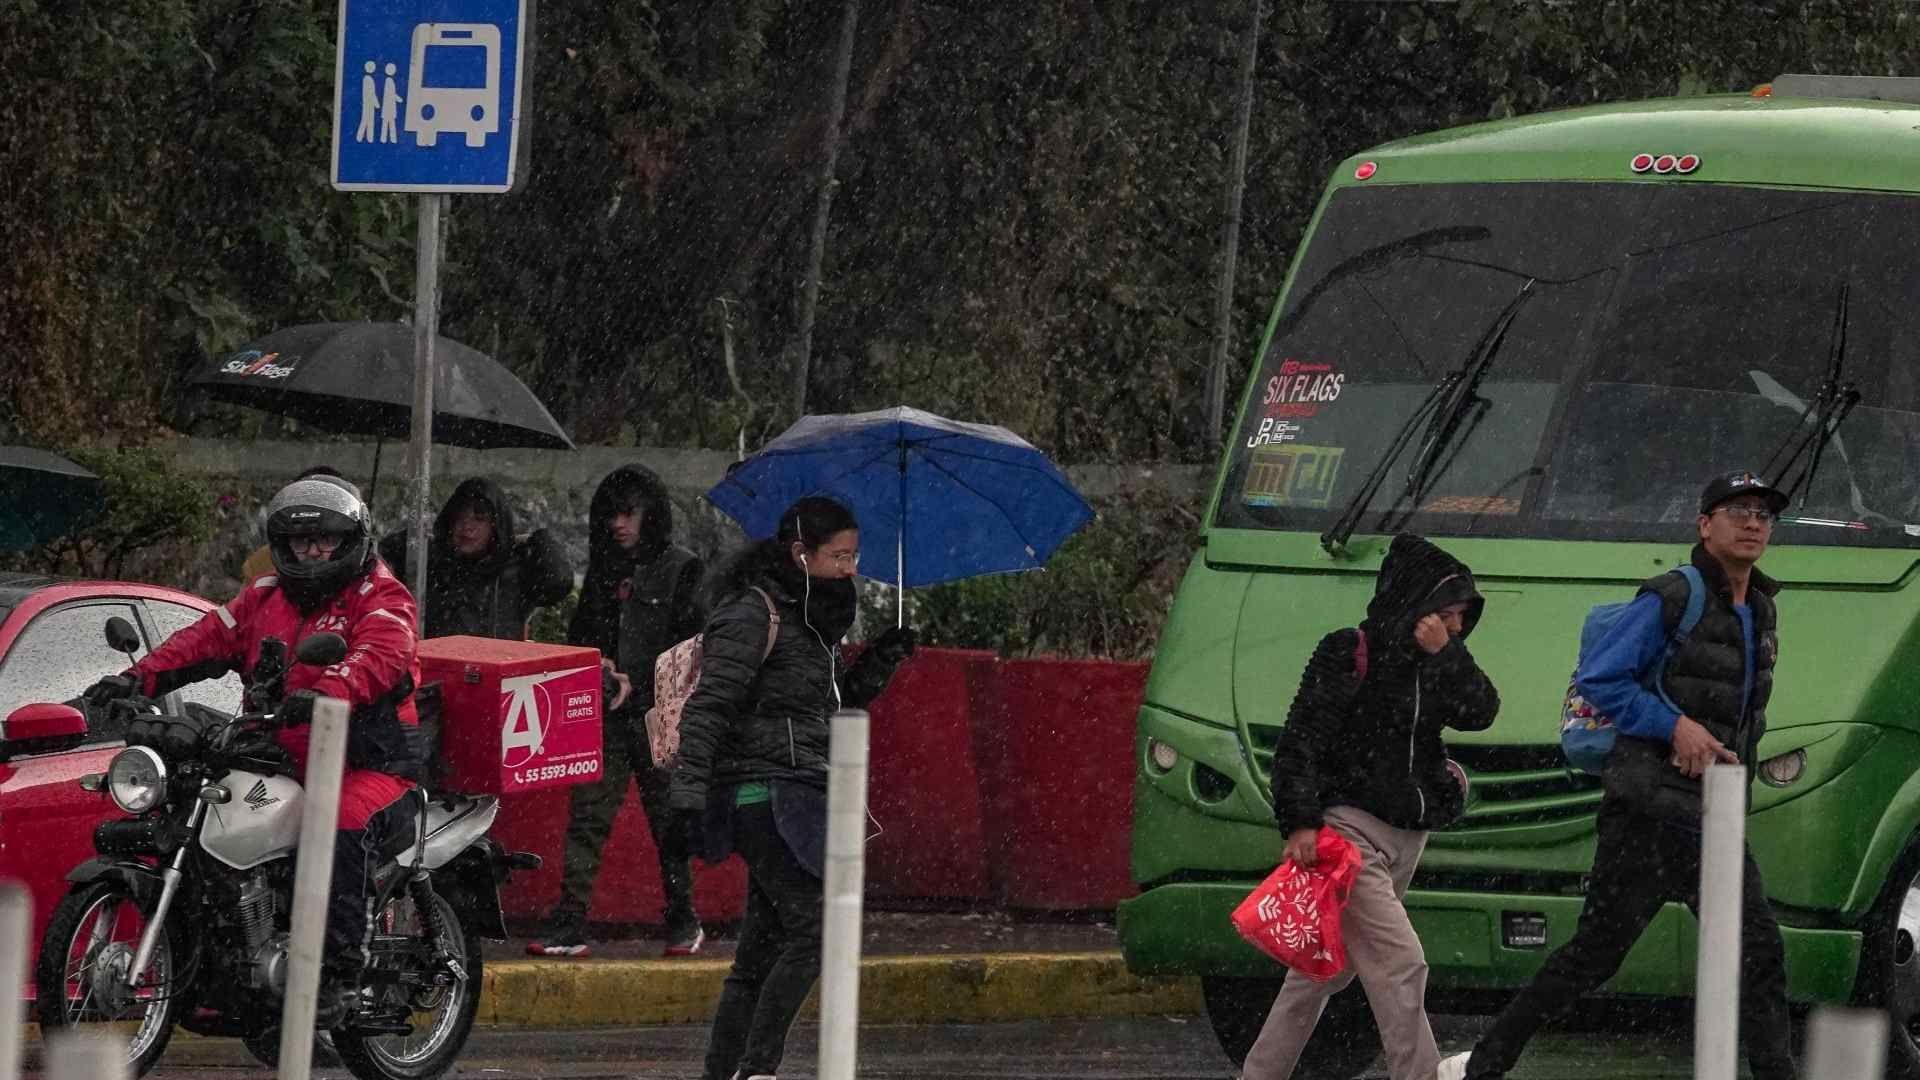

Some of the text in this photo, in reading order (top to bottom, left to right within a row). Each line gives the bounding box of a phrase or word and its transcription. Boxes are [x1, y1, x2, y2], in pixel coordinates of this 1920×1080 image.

[1263, 373, 1345, 405] SIX FLAGS
[567, 694, 592, 707] ENVÍO
[566, 706, 593, 719] GRATIS
[525, 759, 598, 783] 55 5593 4000
